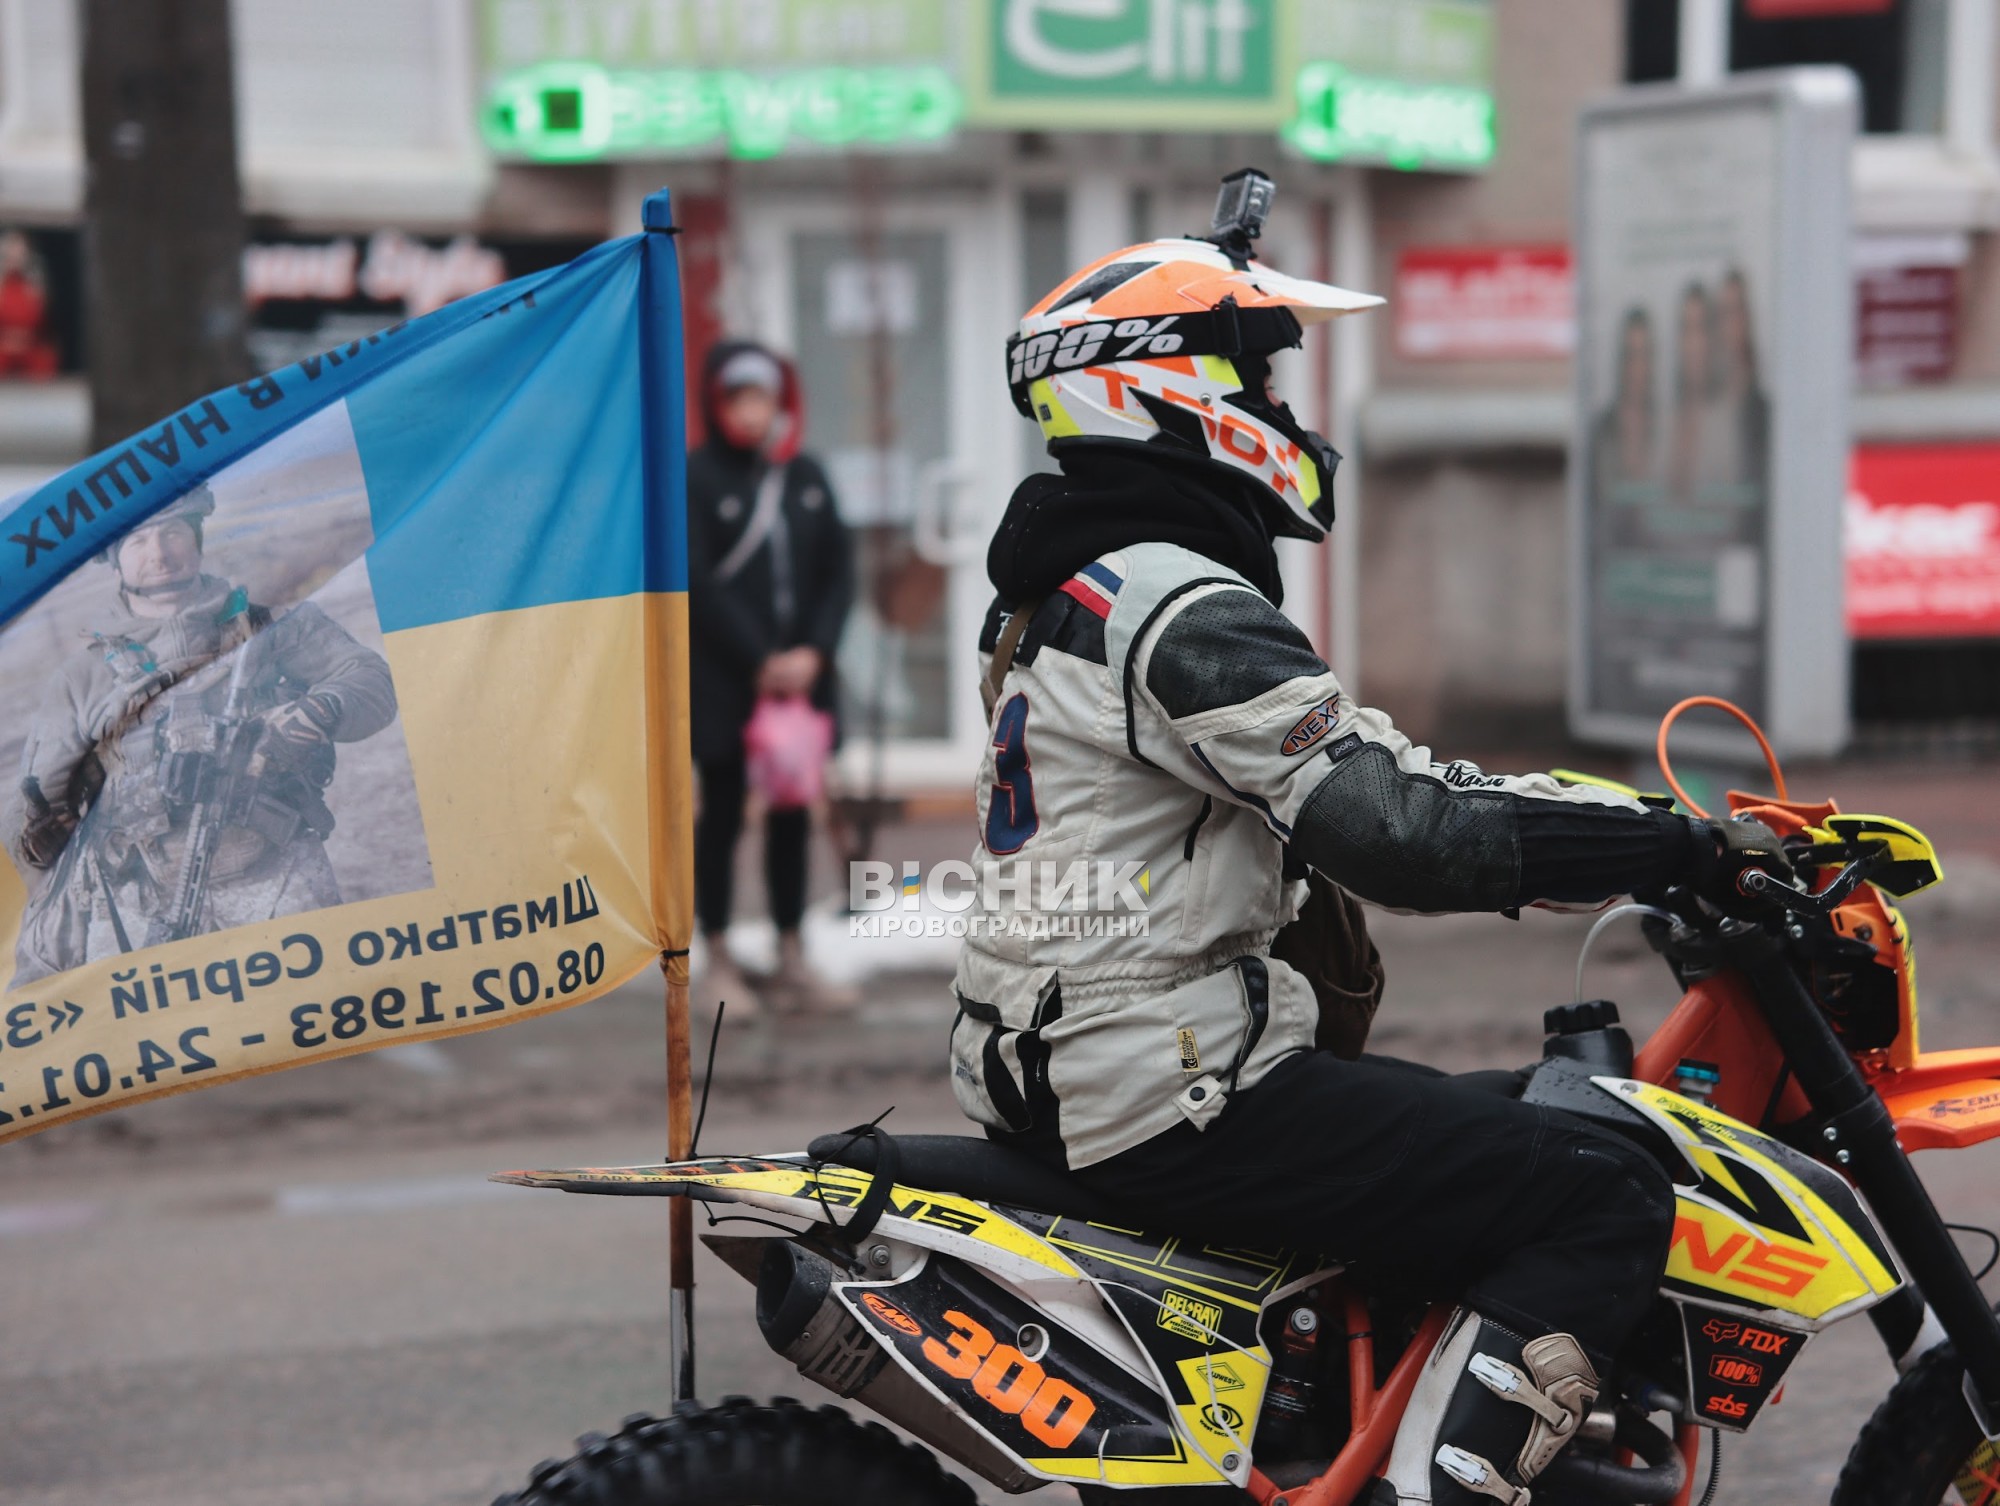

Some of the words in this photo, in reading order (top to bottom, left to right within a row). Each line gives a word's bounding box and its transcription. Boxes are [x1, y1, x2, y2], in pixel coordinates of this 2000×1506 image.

[1010, 316, 1184, 385] 100%
[8, 398, 231, 569] НАШИХ
[576, 1173, 633, 1182] READY
[1669, 1215, 1830, 1299] NS
[1738, 1327, 1790, 1355] FOX
[921, 1309, 1096, 1449] 300
[1714, 1359, 1760, 1384] 100%
[1705, 1393, 1749, 1416] sbs
